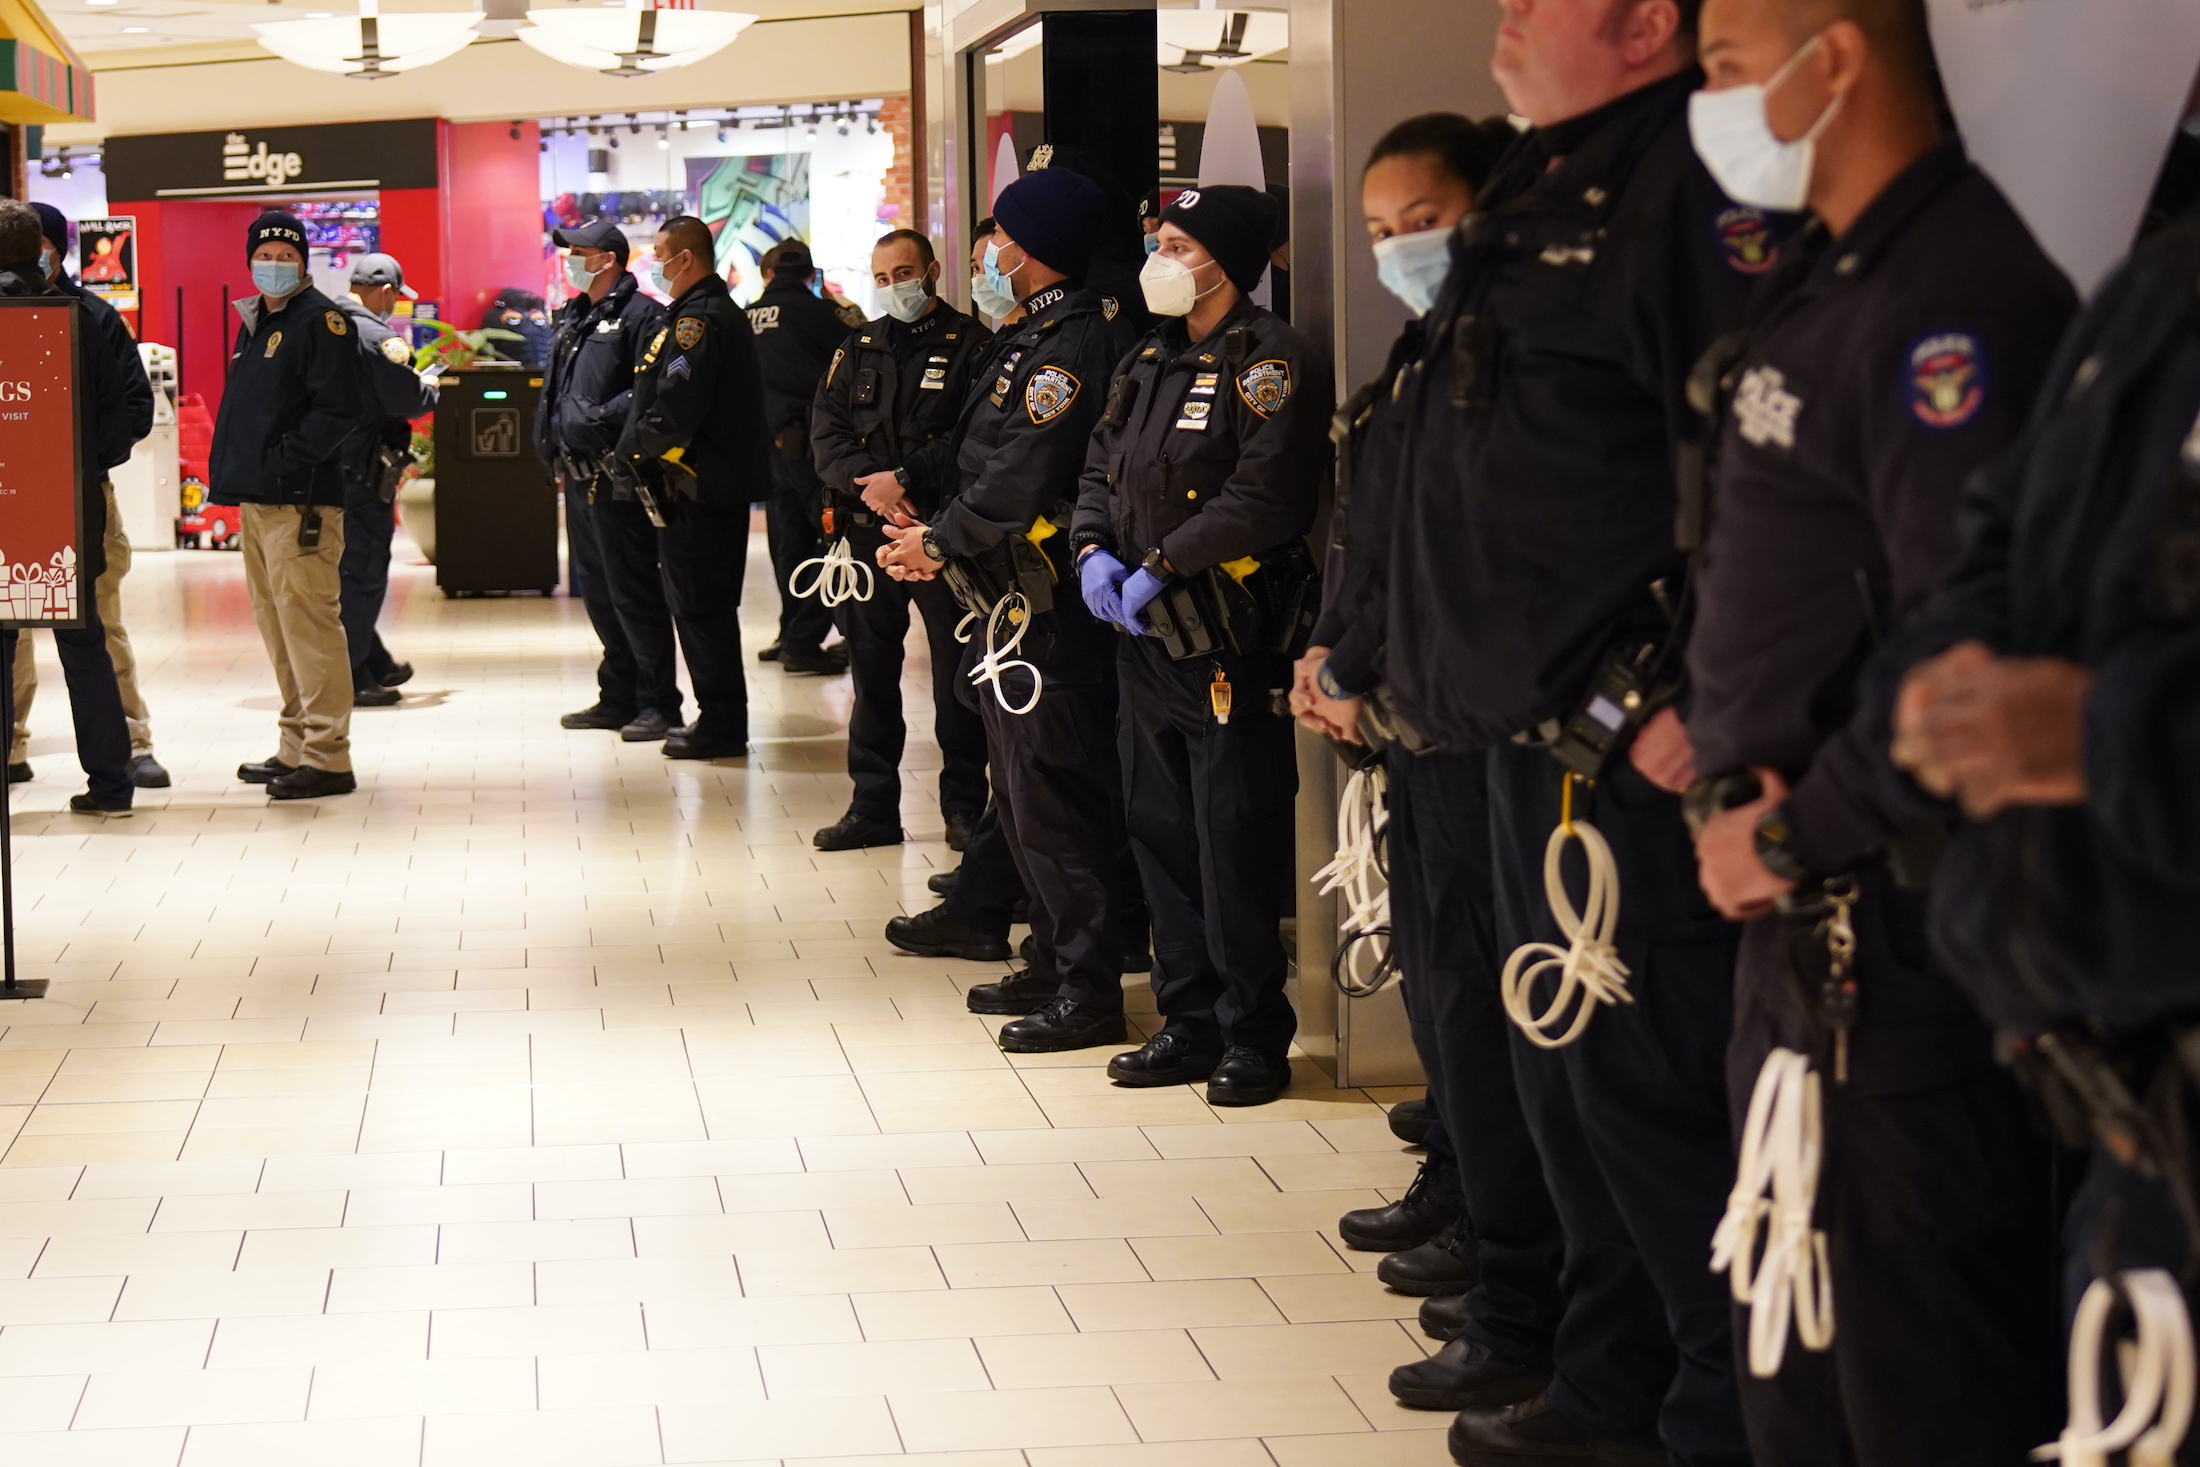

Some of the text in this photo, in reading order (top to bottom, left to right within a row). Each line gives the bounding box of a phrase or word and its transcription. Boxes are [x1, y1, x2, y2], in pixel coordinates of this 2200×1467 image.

[225, 132, 246, 144] the
[222, 141, 303, 186] Edge
[259, 227, 300, 242] NYPD
[1028, 288, 1064, 314] NYPD
[911, 318, 936, 334] NYPD
[1045, 369, 1069, 384] POLICE
[1242, 369, 1285, 387] DEPARTMENT
[1249, 363, 1275, 377] POLICE
[1034, 374, 1073, 395] DEPARTMENT
[1042, 397, 1071, 419] NEW YORK
[1244, 391, 1258, 406] CITY
[1256, 404, 1267, 413] OF
[1, 412, 29, 420] VISIT
